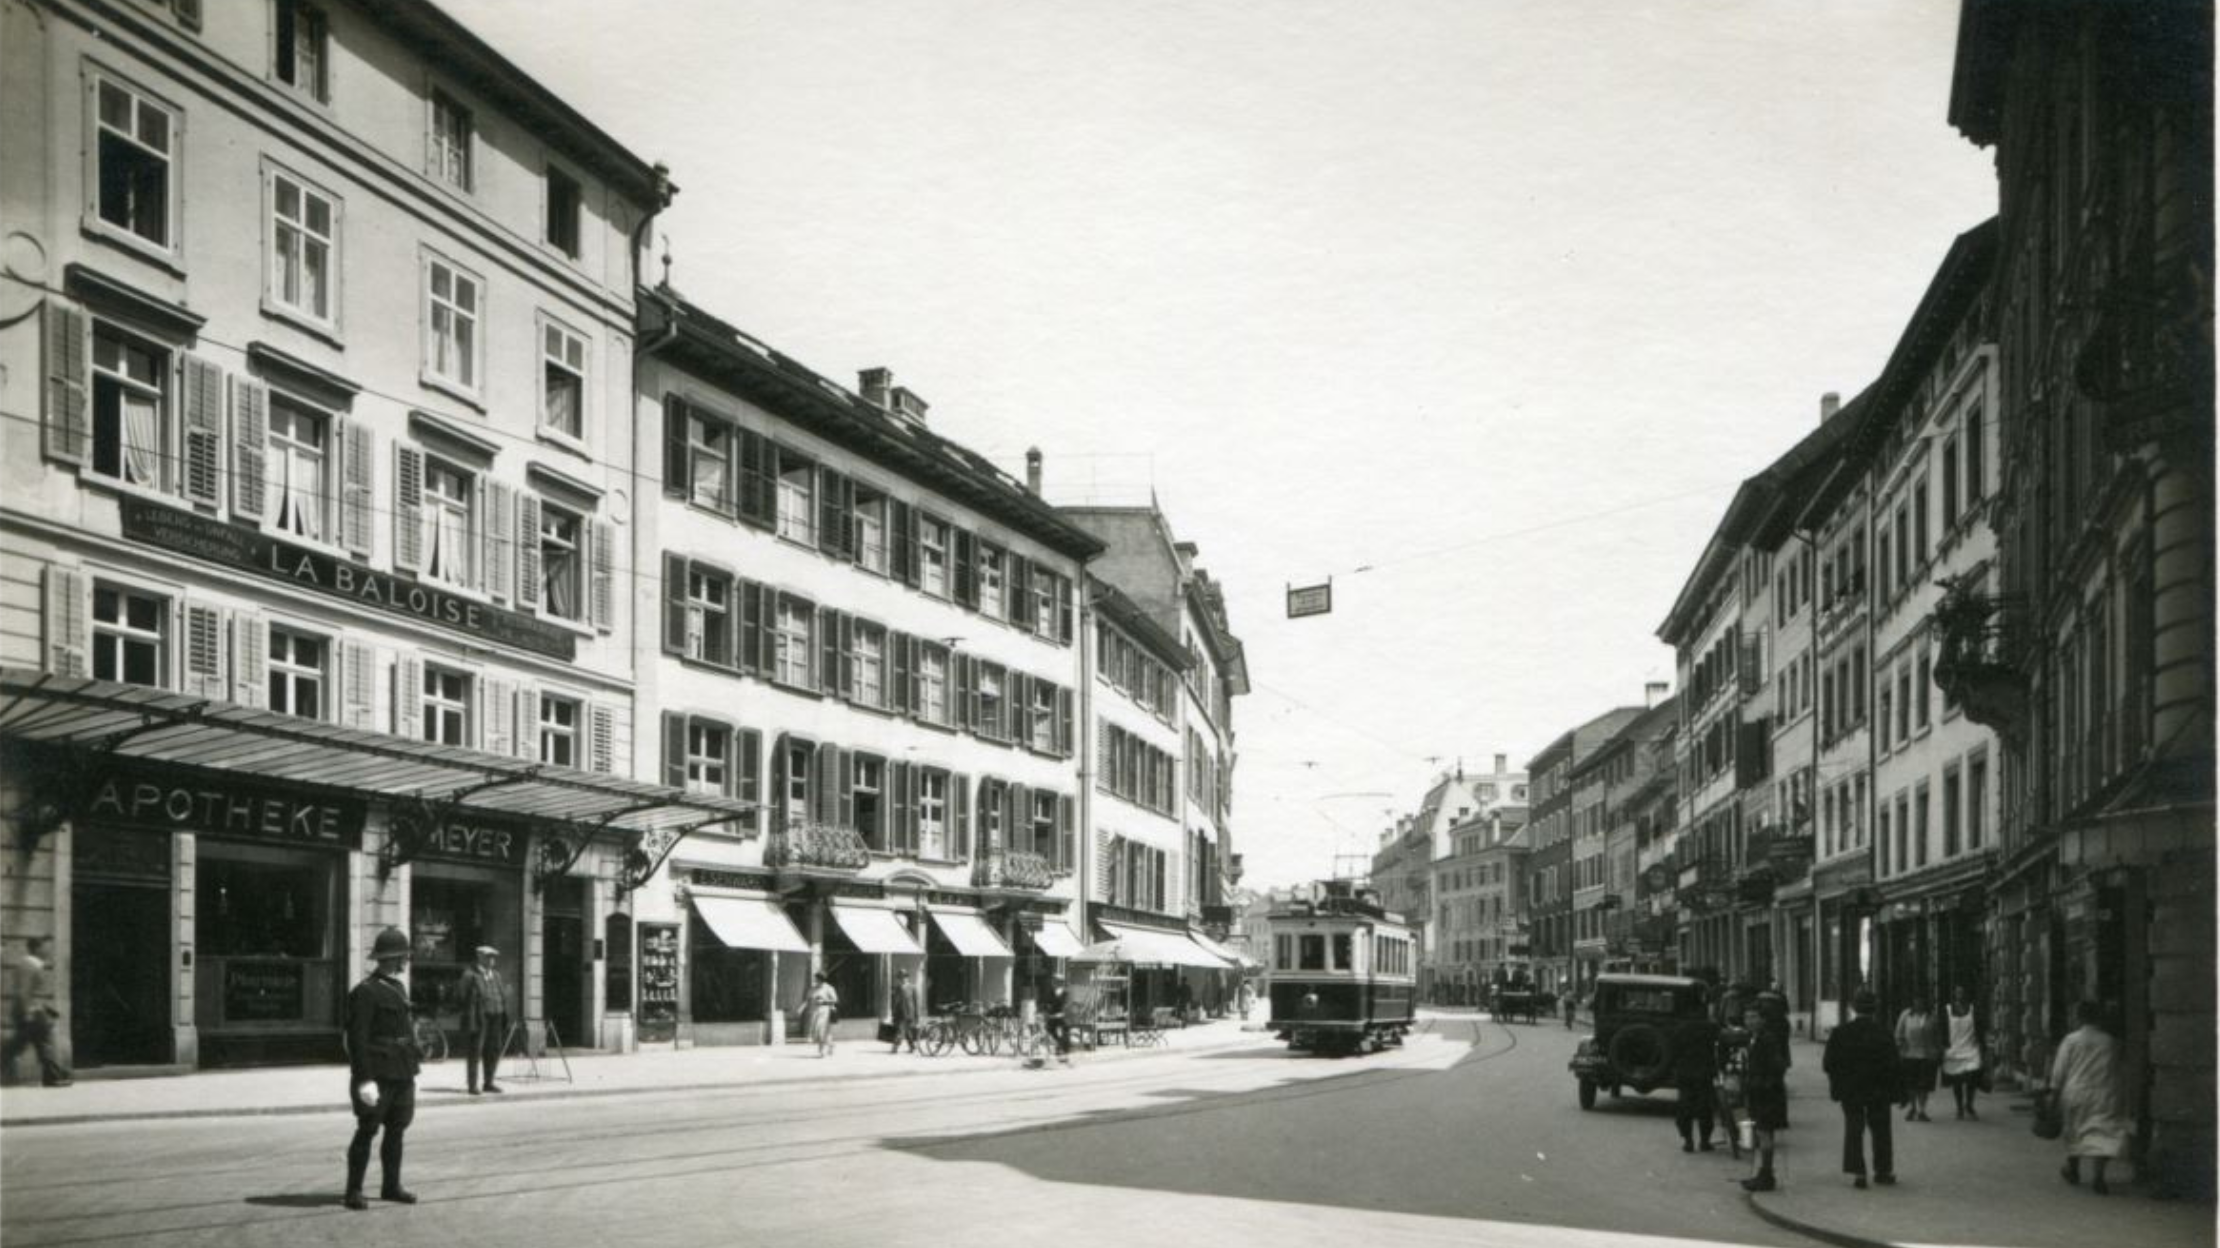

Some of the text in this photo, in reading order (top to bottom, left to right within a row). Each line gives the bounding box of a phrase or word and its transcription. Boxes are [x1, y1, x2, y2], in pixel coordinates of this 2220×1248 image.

[272, 544, 481, 629] LA BALOISE
[90, 780, 341, 839] APOTHEKE
